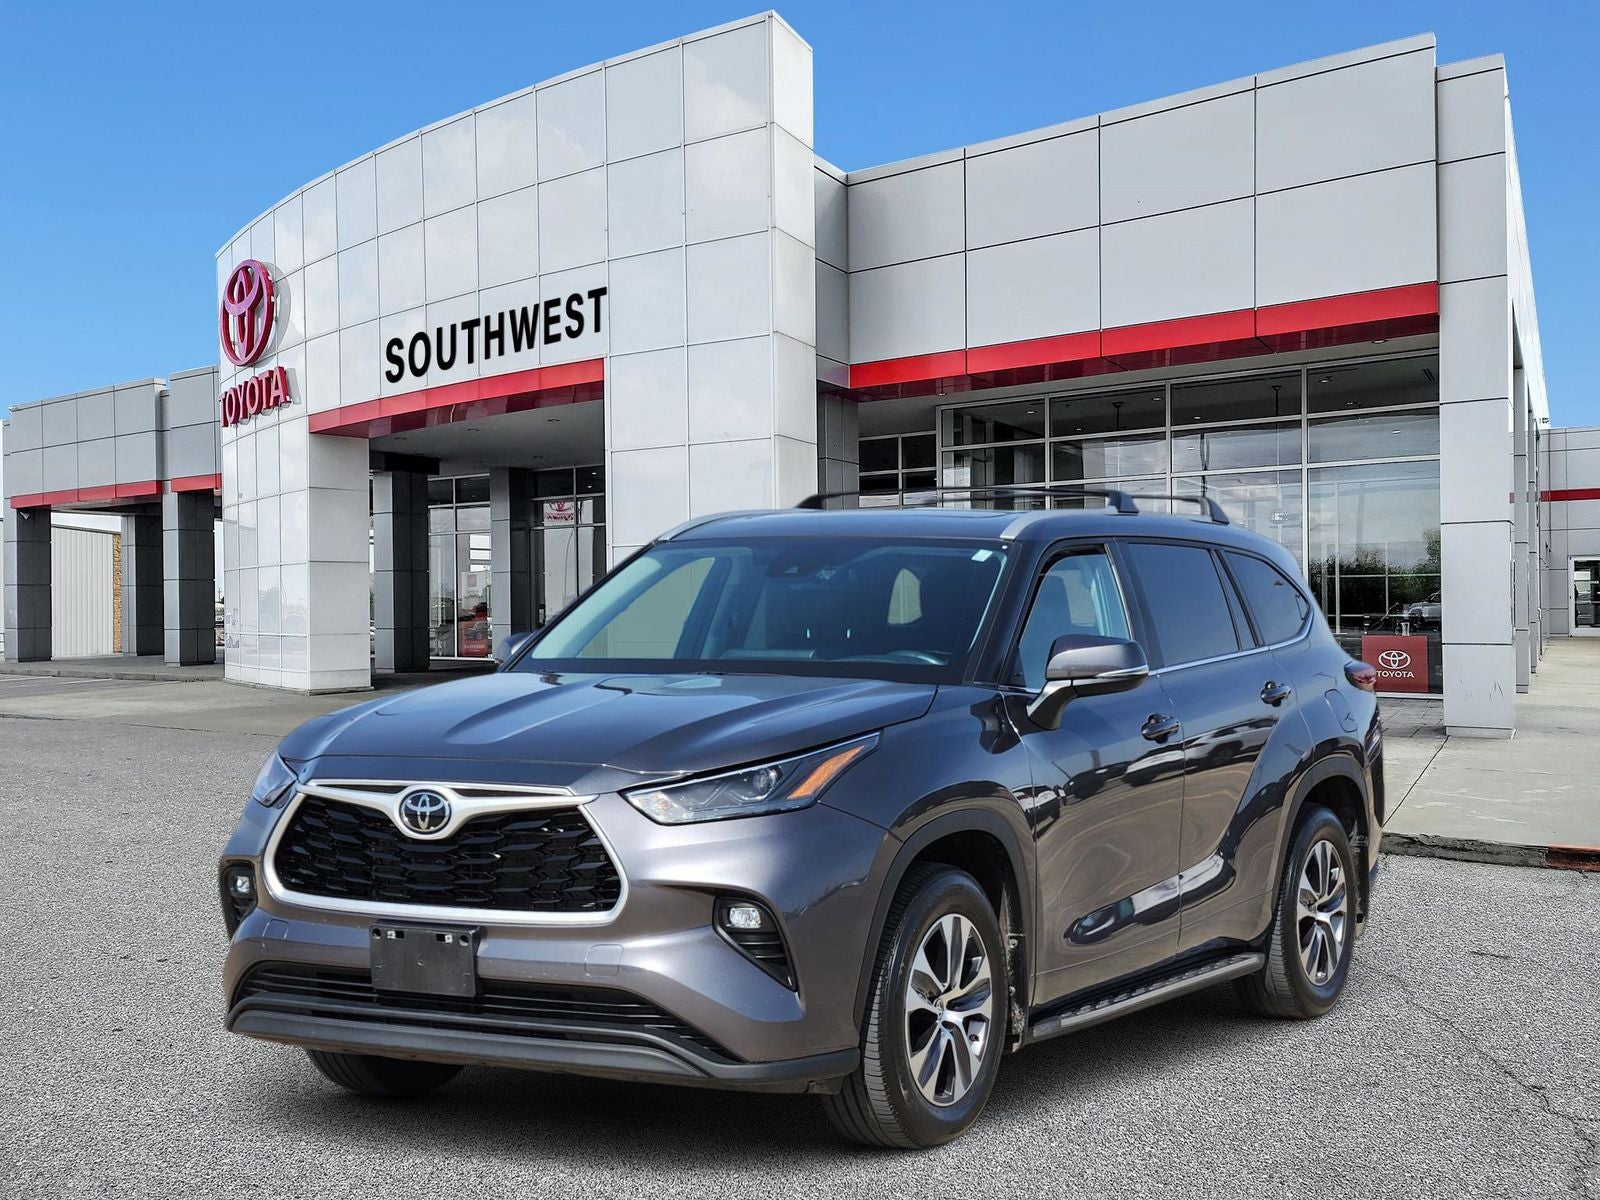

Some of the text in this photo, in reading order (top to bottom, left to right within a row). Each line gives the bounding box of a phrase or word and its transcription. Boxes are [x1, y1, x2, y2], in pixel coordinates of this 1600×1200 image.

[385, 286, 608, 384] SOUTHWEST
[218, 366, 292, 427] TOYOTA
[1376, 670, 1415, 678] TOYOTA
